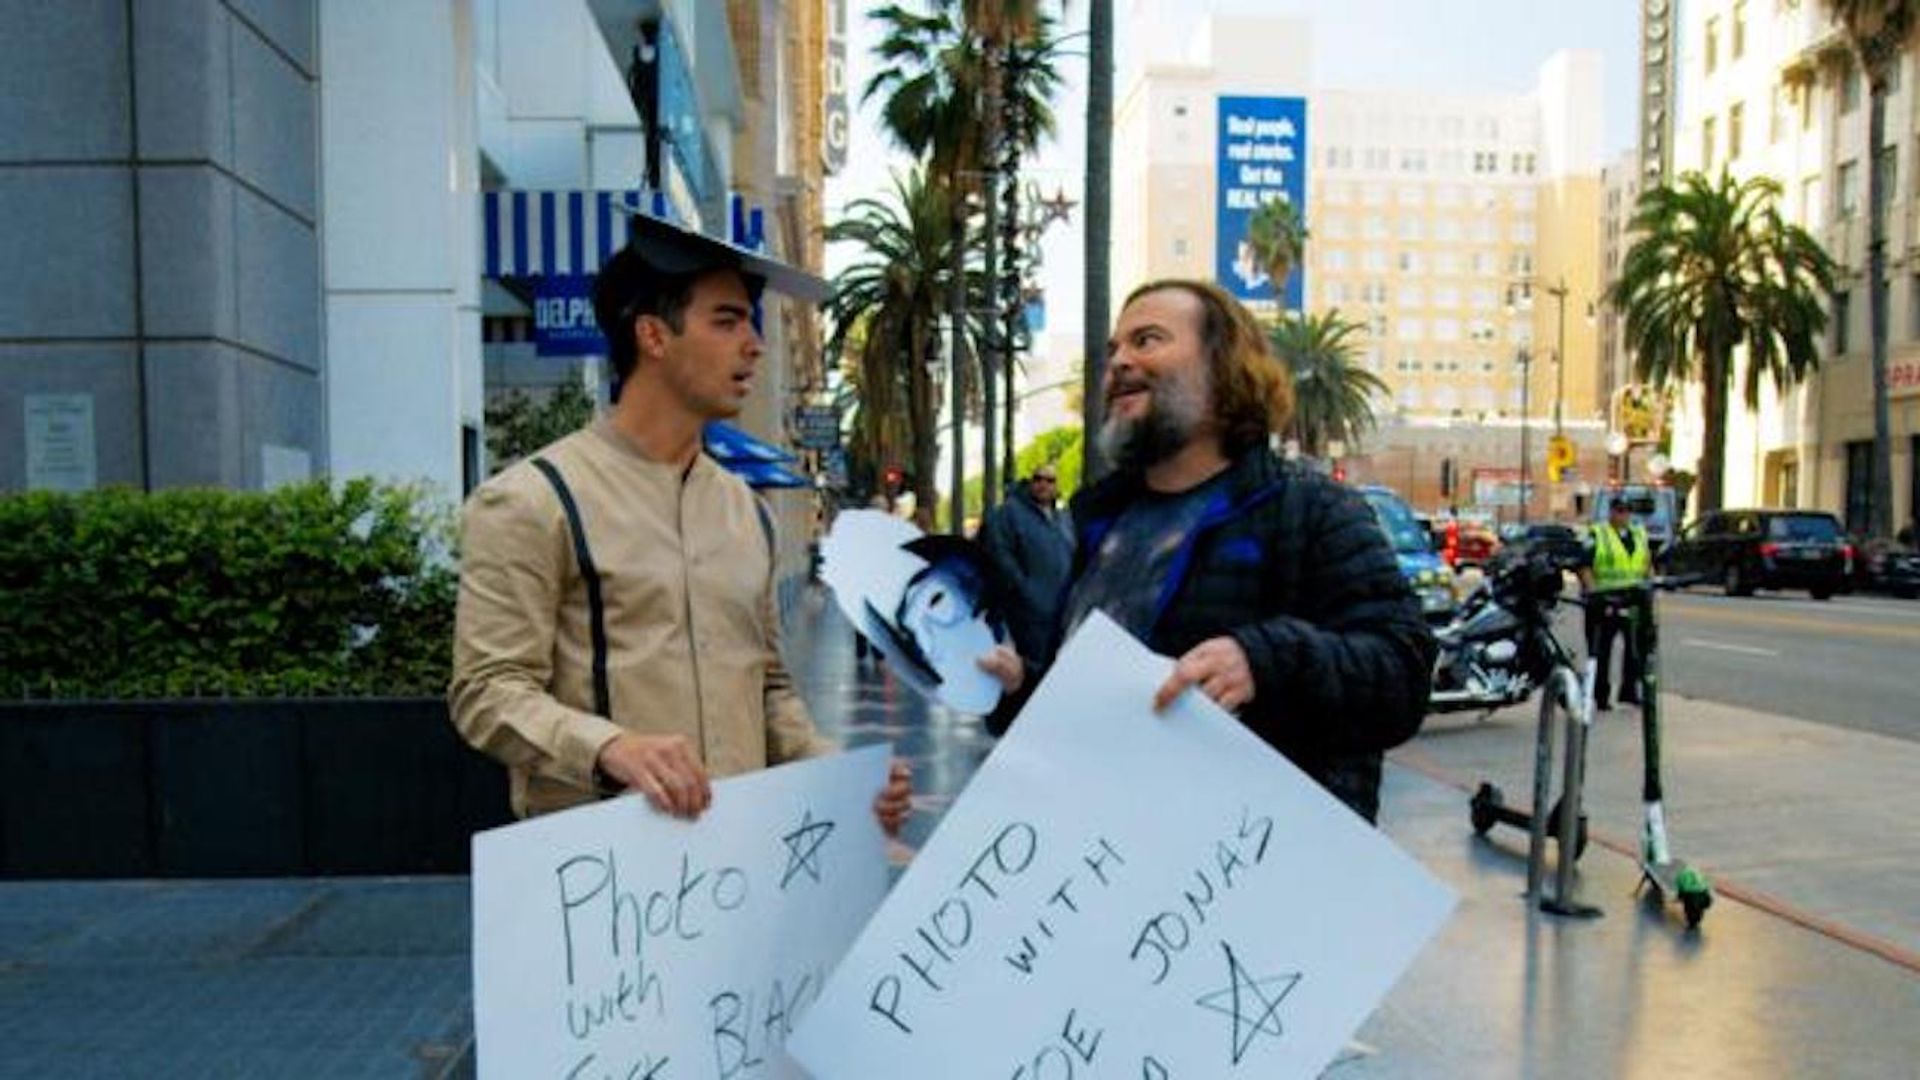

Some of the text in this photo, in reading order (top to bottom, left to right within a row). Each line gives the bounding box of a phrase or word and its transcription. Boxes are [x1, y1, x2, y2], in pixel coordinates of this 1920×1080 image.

[1228, 116, 1254, 134] Real
[1228, 141, 1252, 160] real
[1227, 188, 1257, 208] REAL
[1240, 165, 1283, 184] Get the
[556, 847, 748, 985] Photo
[870, 822, 1037, 1033] PHOTO
[1005, 838, 1126, 976] WITH
[1010, 804, 1274, 1080] OE JONAS
[566, 962, 666, 1040] with
